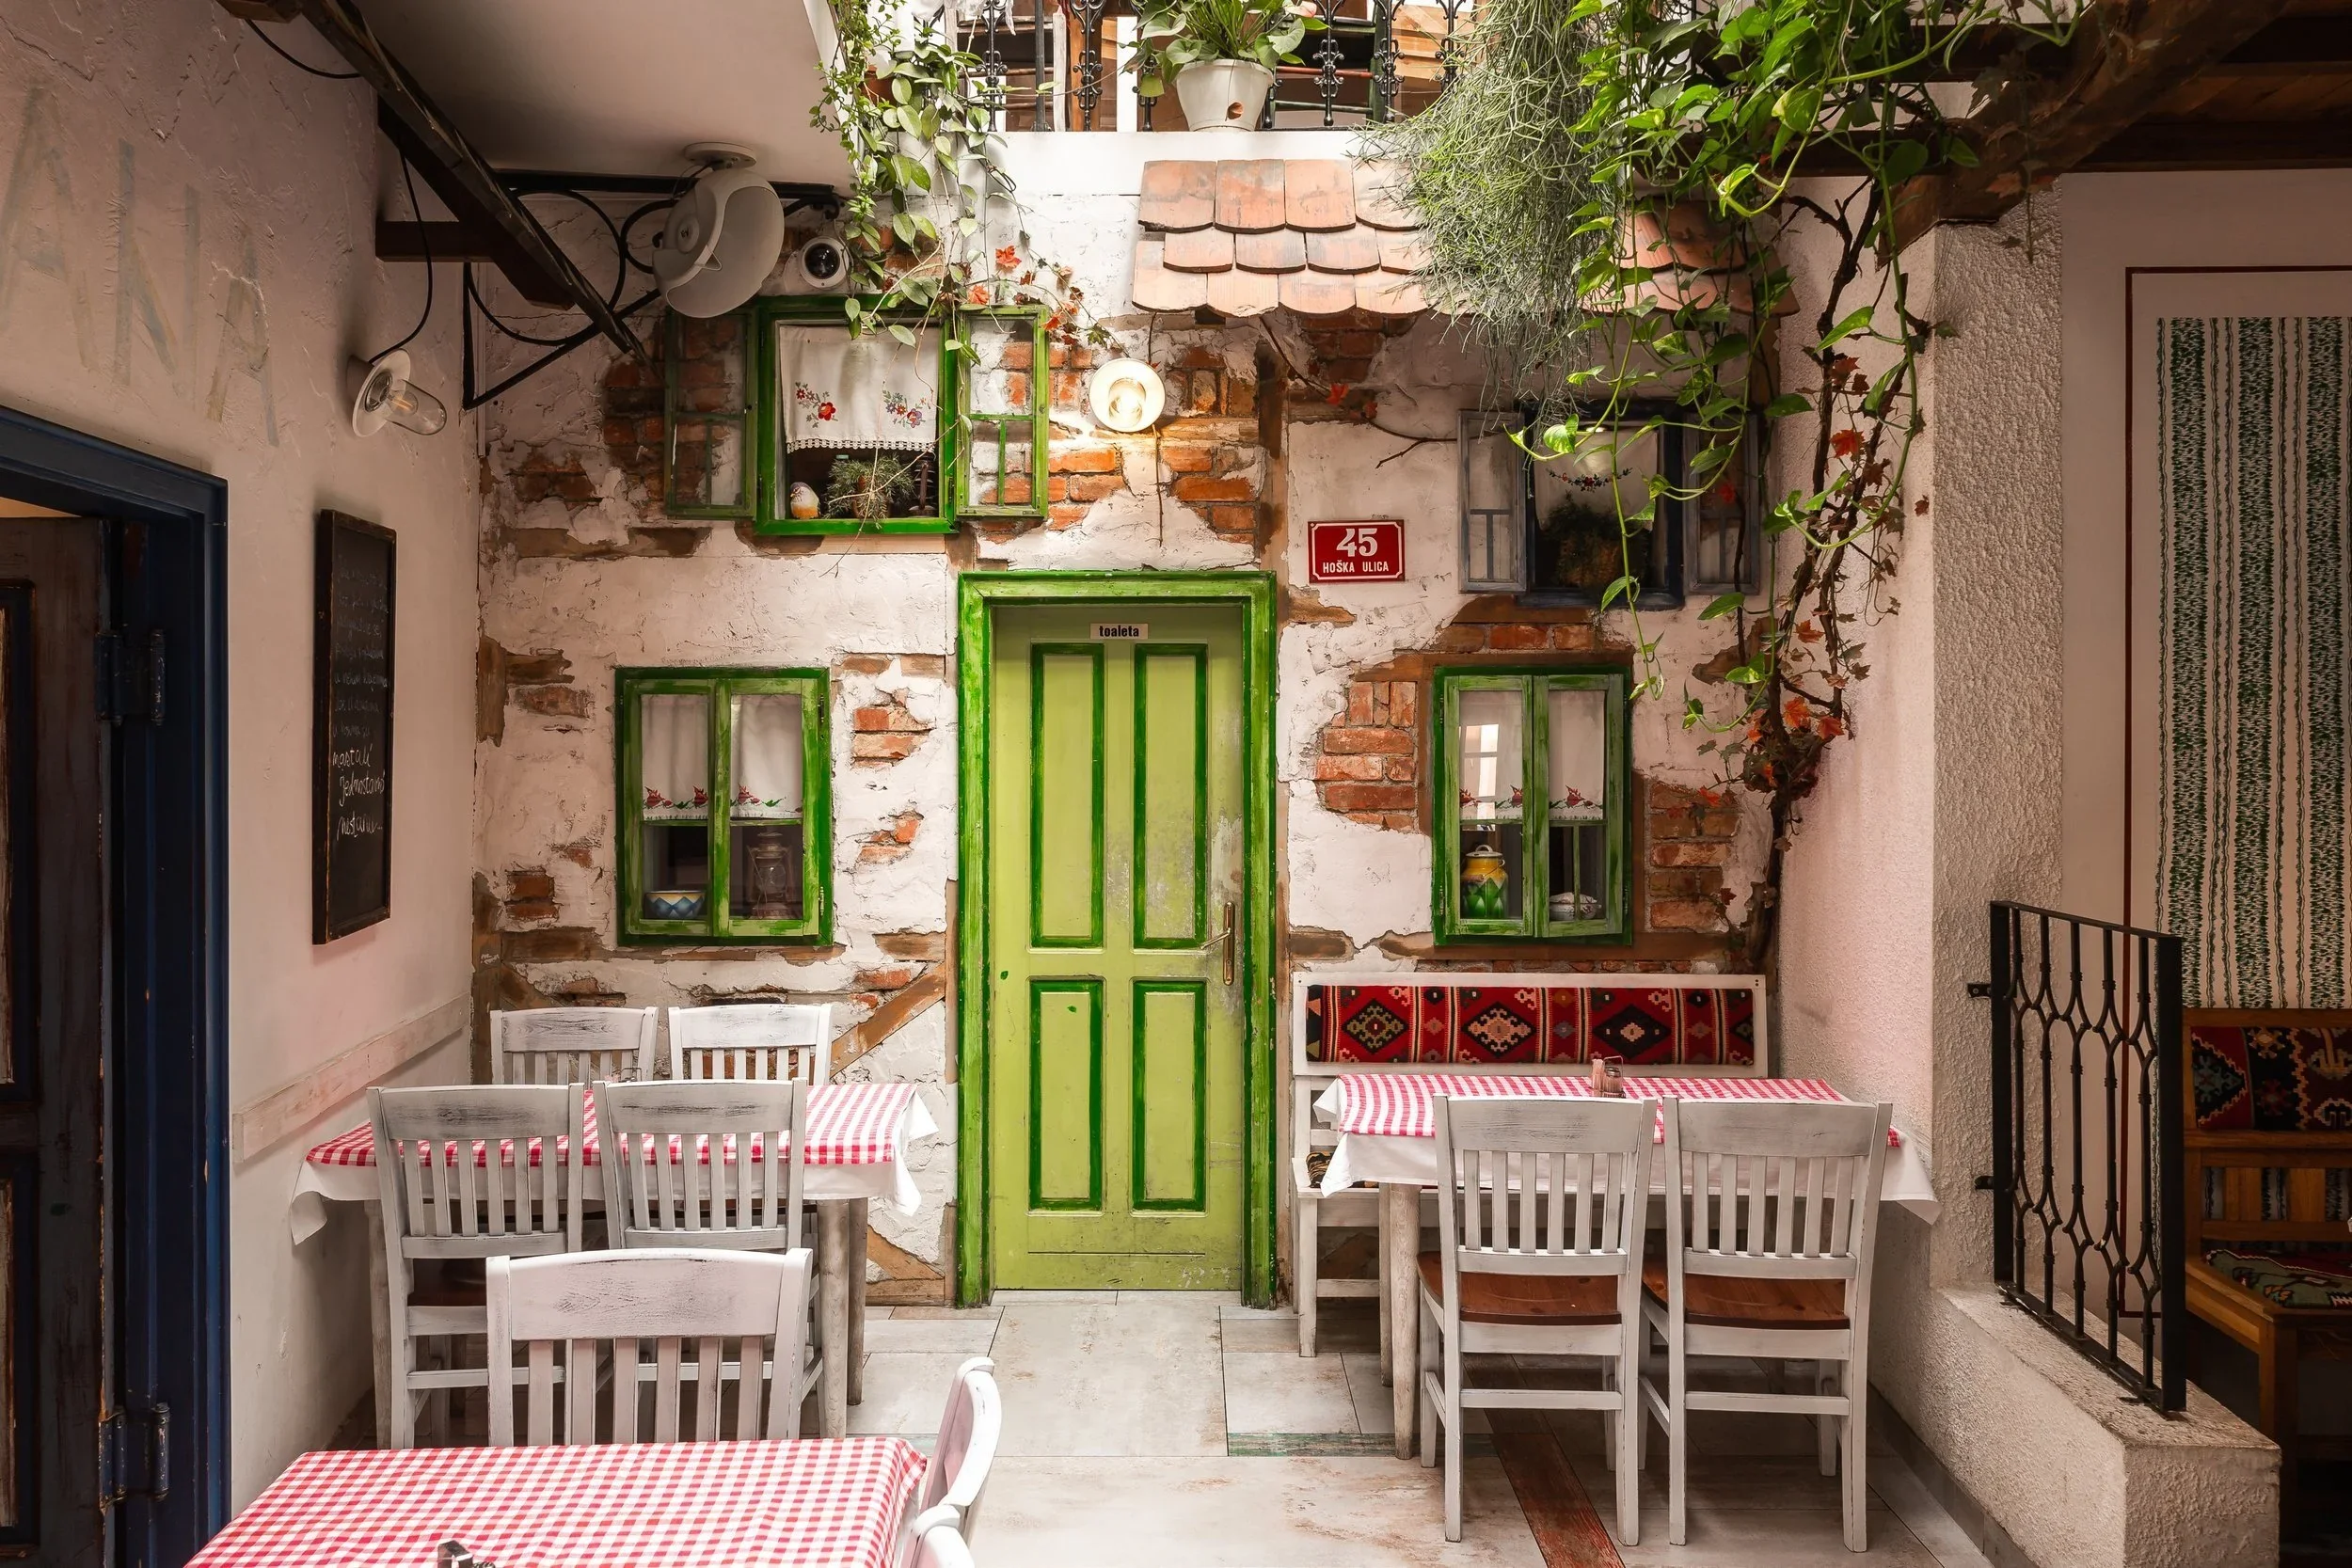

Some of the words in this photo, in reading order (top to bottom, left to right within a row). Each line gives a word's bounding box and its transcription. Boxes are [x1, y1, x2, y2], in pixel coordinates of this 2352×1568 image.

[1336, 528, 1378, 557] 45
[1323, 560, 1355, 573] HOŠKA
[1362, 562, 1389, 572] ULICA
[1099, 625, 1139, 637] toaleta
